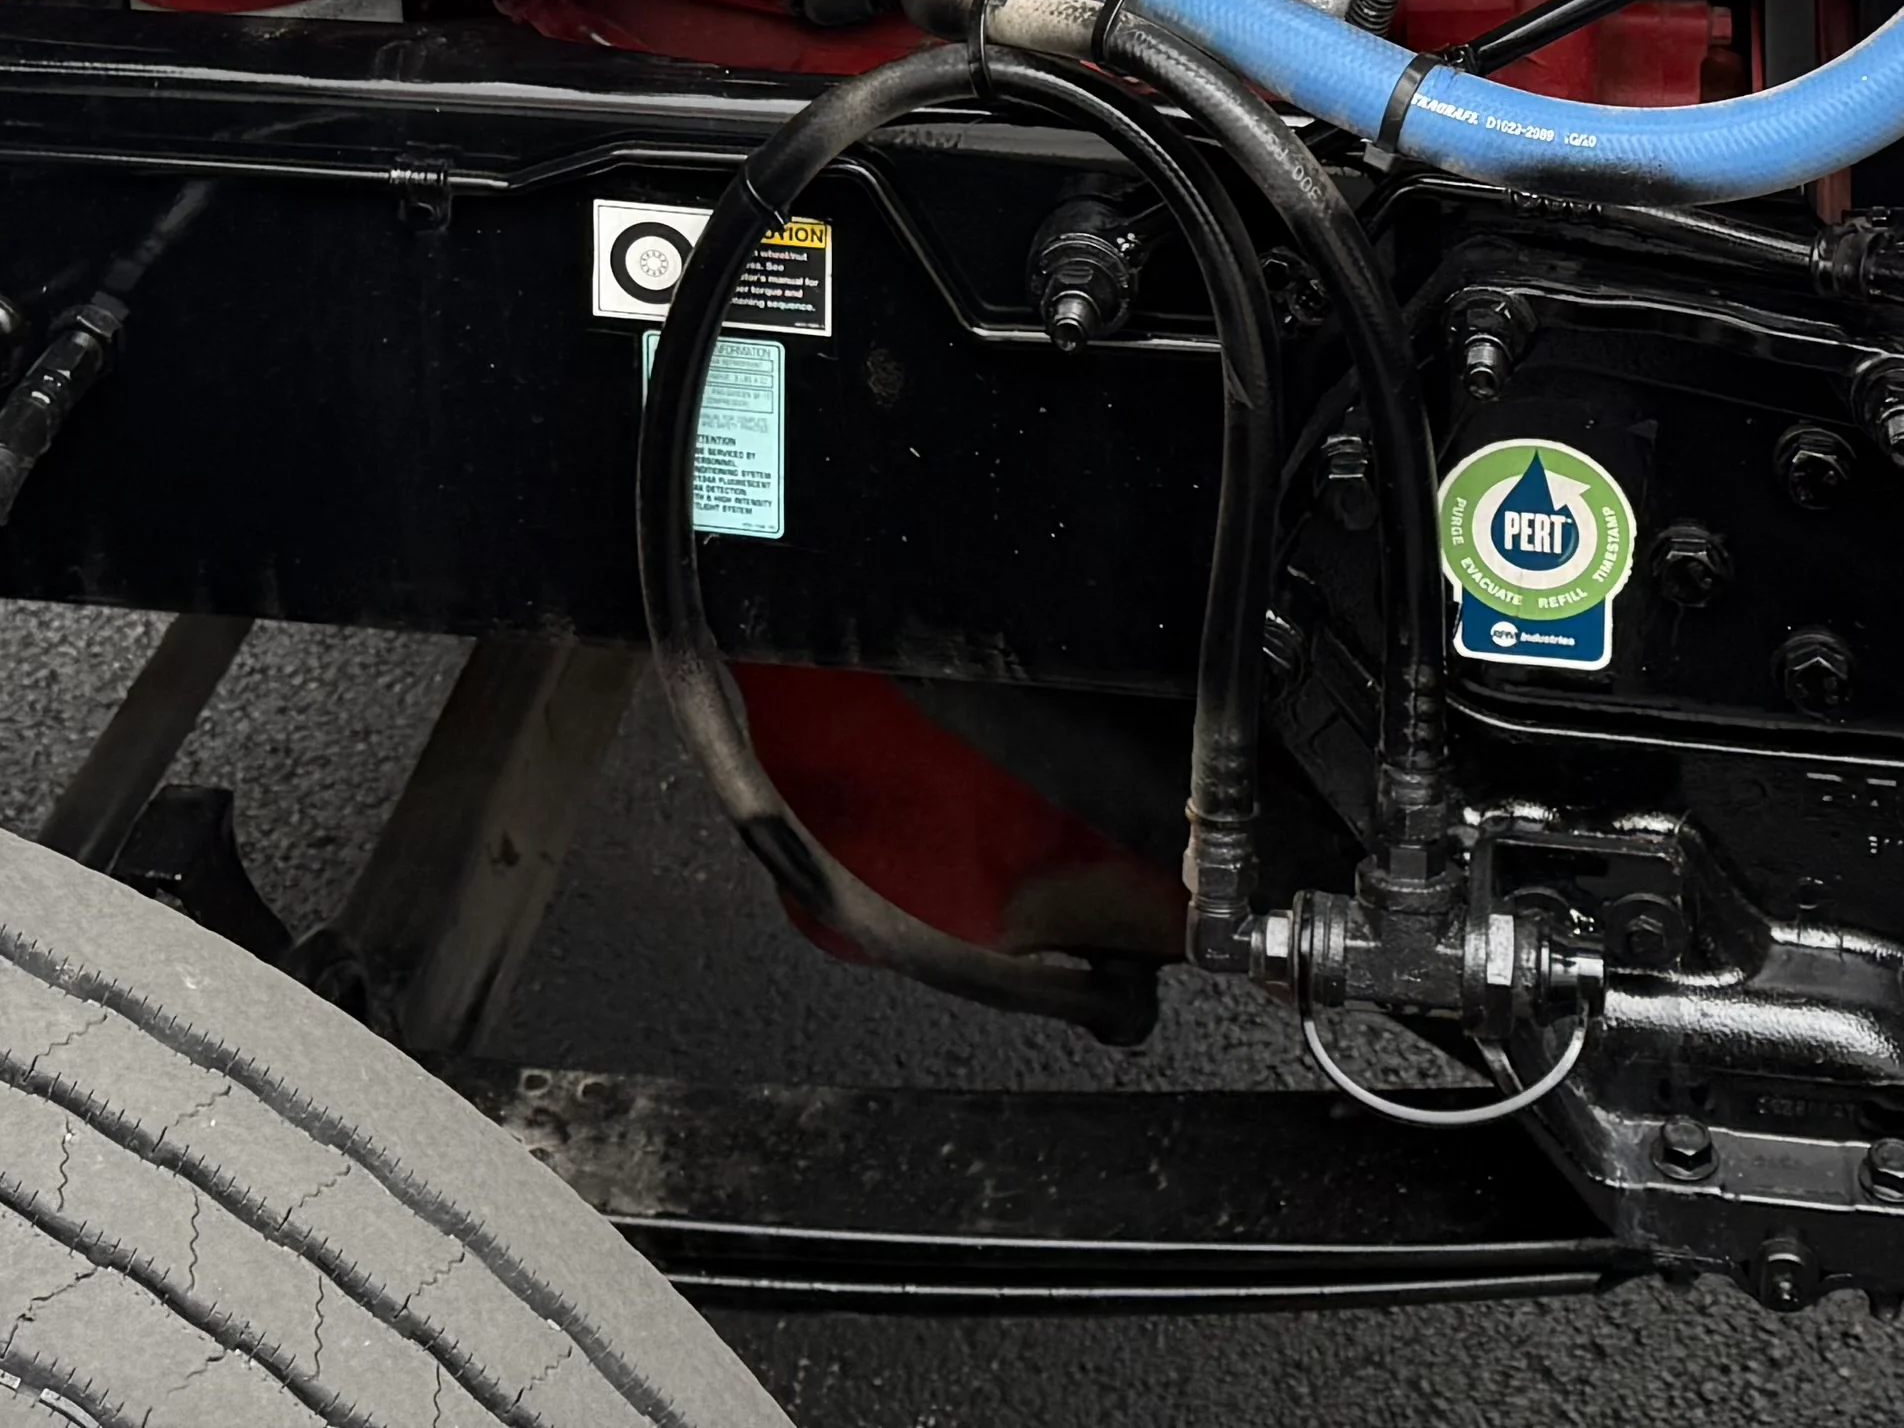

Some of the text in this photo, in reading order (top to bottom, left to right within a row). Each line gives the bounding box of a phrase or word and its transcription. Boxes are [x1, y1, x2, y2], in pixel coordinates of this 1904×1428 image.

[714, 345, 771, 358] NFORMATION
[696, 434, 736, 446] TTENTION
[696, 475, 717, 484] 134A
[1450, 496, 1468, 546] PURGE
[1504, 511, 1566, 554] PERT
[1591, 505, 1621, 583] TIMESTAMP
[1460, 556, 1524, 606] EVACUATE
[1538, 587, 1589, 609] REFILL
